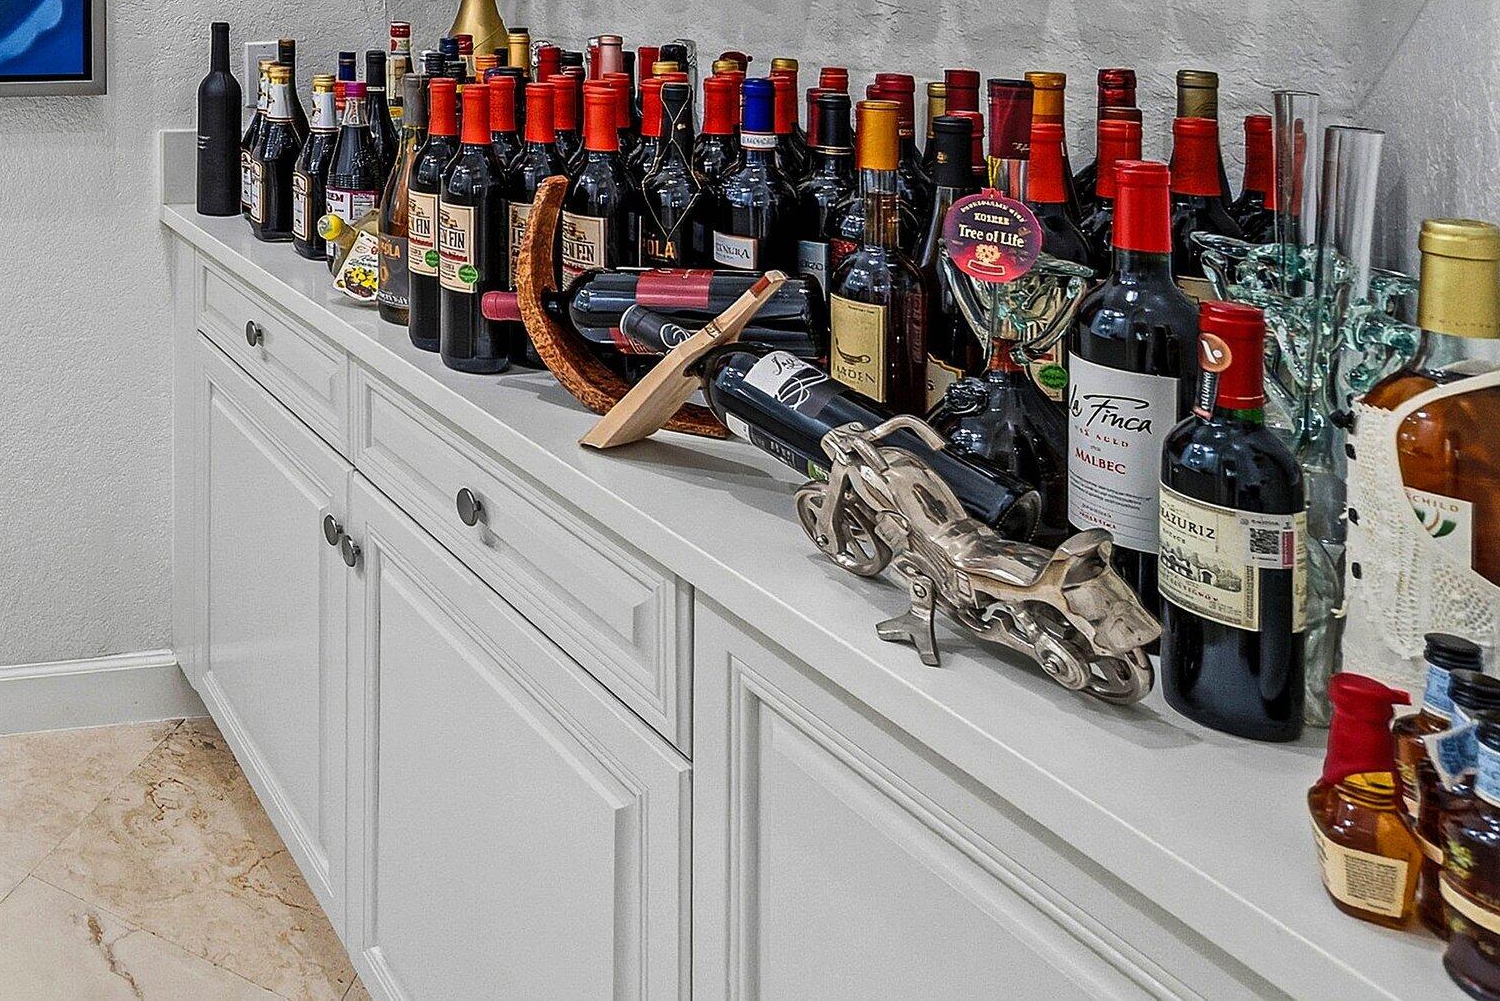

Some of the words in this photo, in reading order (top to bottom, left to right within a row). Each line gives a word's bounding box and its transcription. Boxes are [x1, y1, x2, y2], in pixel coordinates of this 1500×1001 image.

[959, 224, 984, 240] Tree
[986, 230, 999, 243] of
[1001, 231, 1025, 248] Life
[1083, 394, 1153, 435] Finca
[1075, 447, 1126, 475] MALBEC
